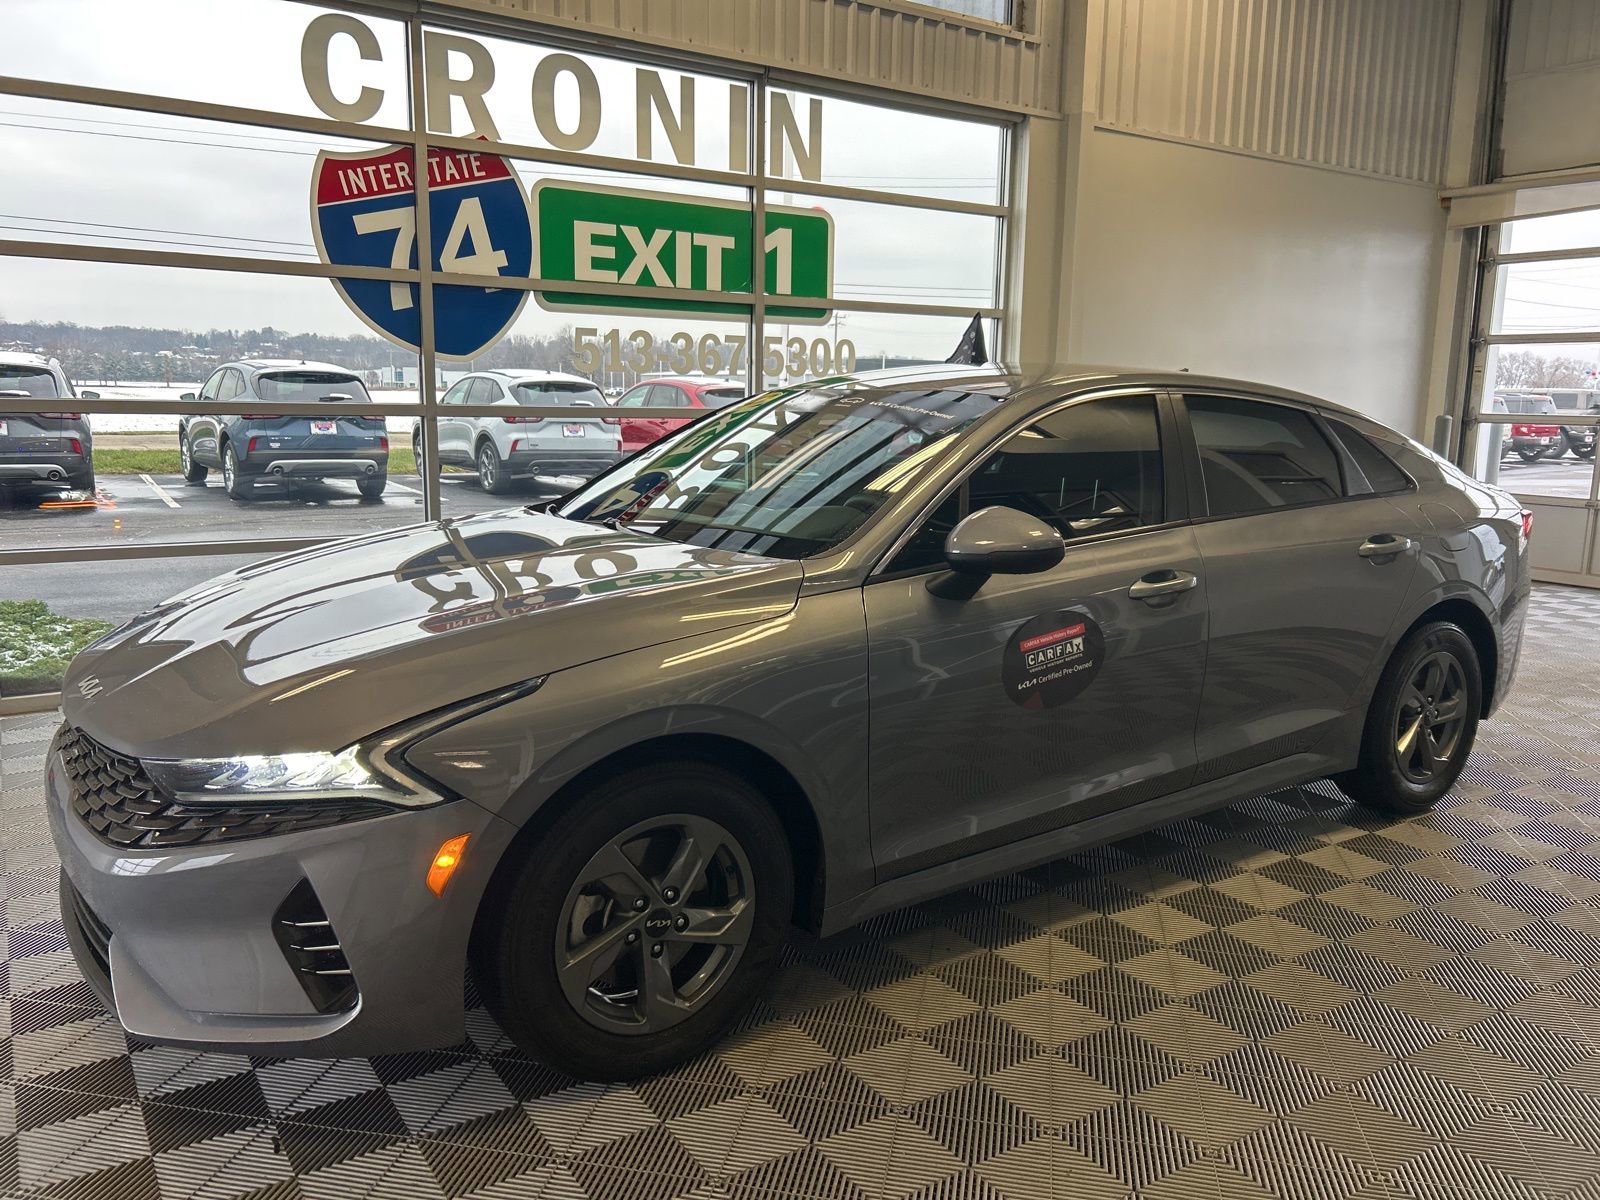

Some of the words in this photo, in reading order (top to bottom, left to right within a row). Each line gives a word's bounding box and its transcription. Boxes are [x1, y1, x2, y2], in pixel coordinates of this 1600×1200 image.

[300, 12, 823, 183] CRONIN
[338, 153, 487, 196] INTERTATE
[352, 197, 509, 311] 74
[573, 219, 736, 292] EXIT
[764, 227, 793, 295] 1
[572, 327, 857, 378] 513-3675300
[1026, 639, 1084, 667] CARFAX
[1038, 670, 1063, 683] Certified
[1063, 660, 1093, 675] Pre-Owned
